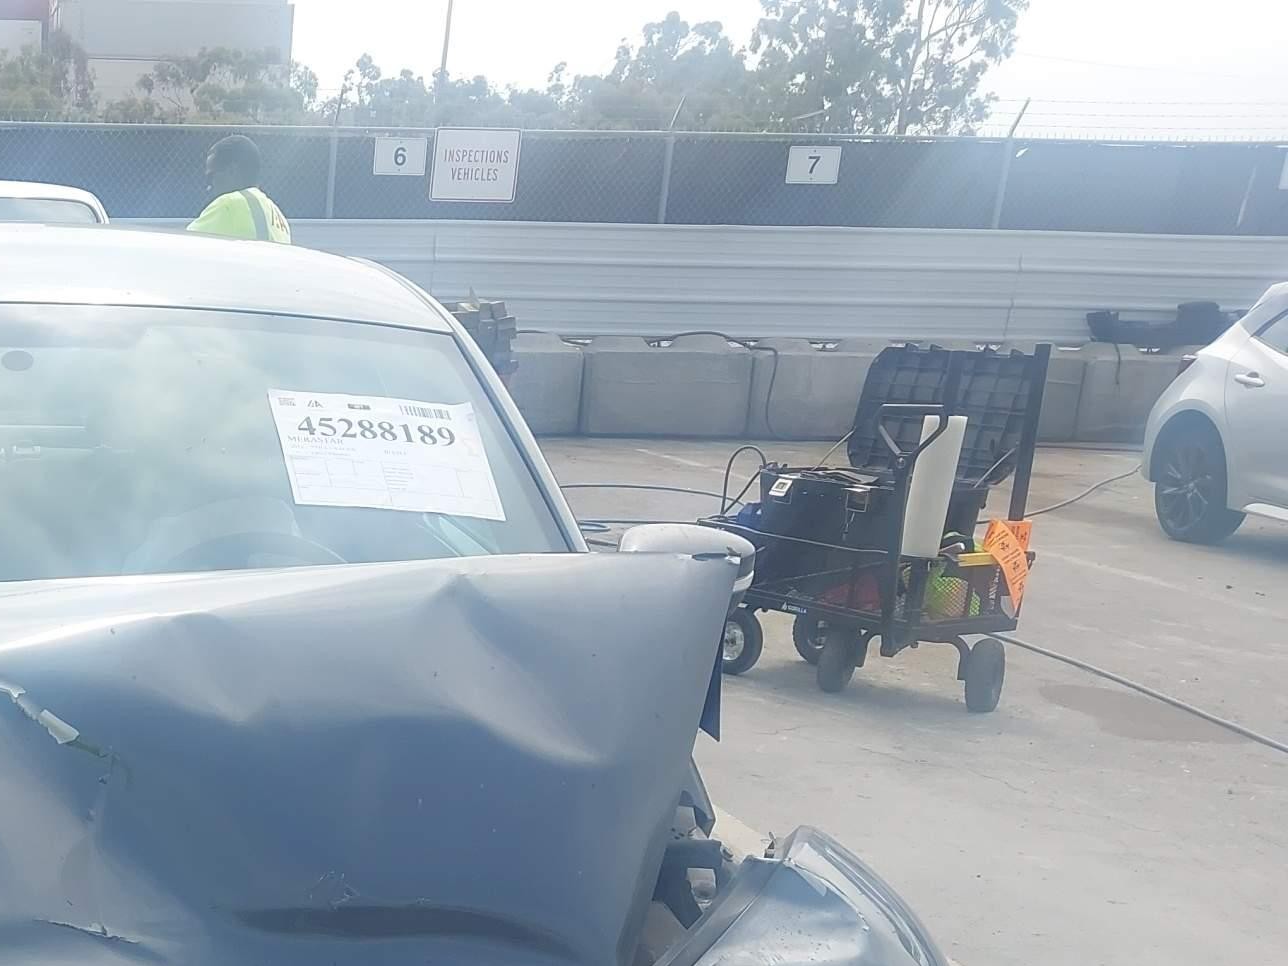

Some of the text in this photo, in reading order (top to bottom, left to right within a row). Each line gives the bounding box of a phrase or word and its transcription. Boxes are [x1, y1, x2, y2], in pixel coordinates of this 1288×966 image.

[393, 146, 407, 166] 6
[444, 149, 510, 163] INSPECTIONS
[808, 155, 821, 174] 7
[451, 167, 499, 181] VEHICLES
[297, 416, 456, 447] 45288189
